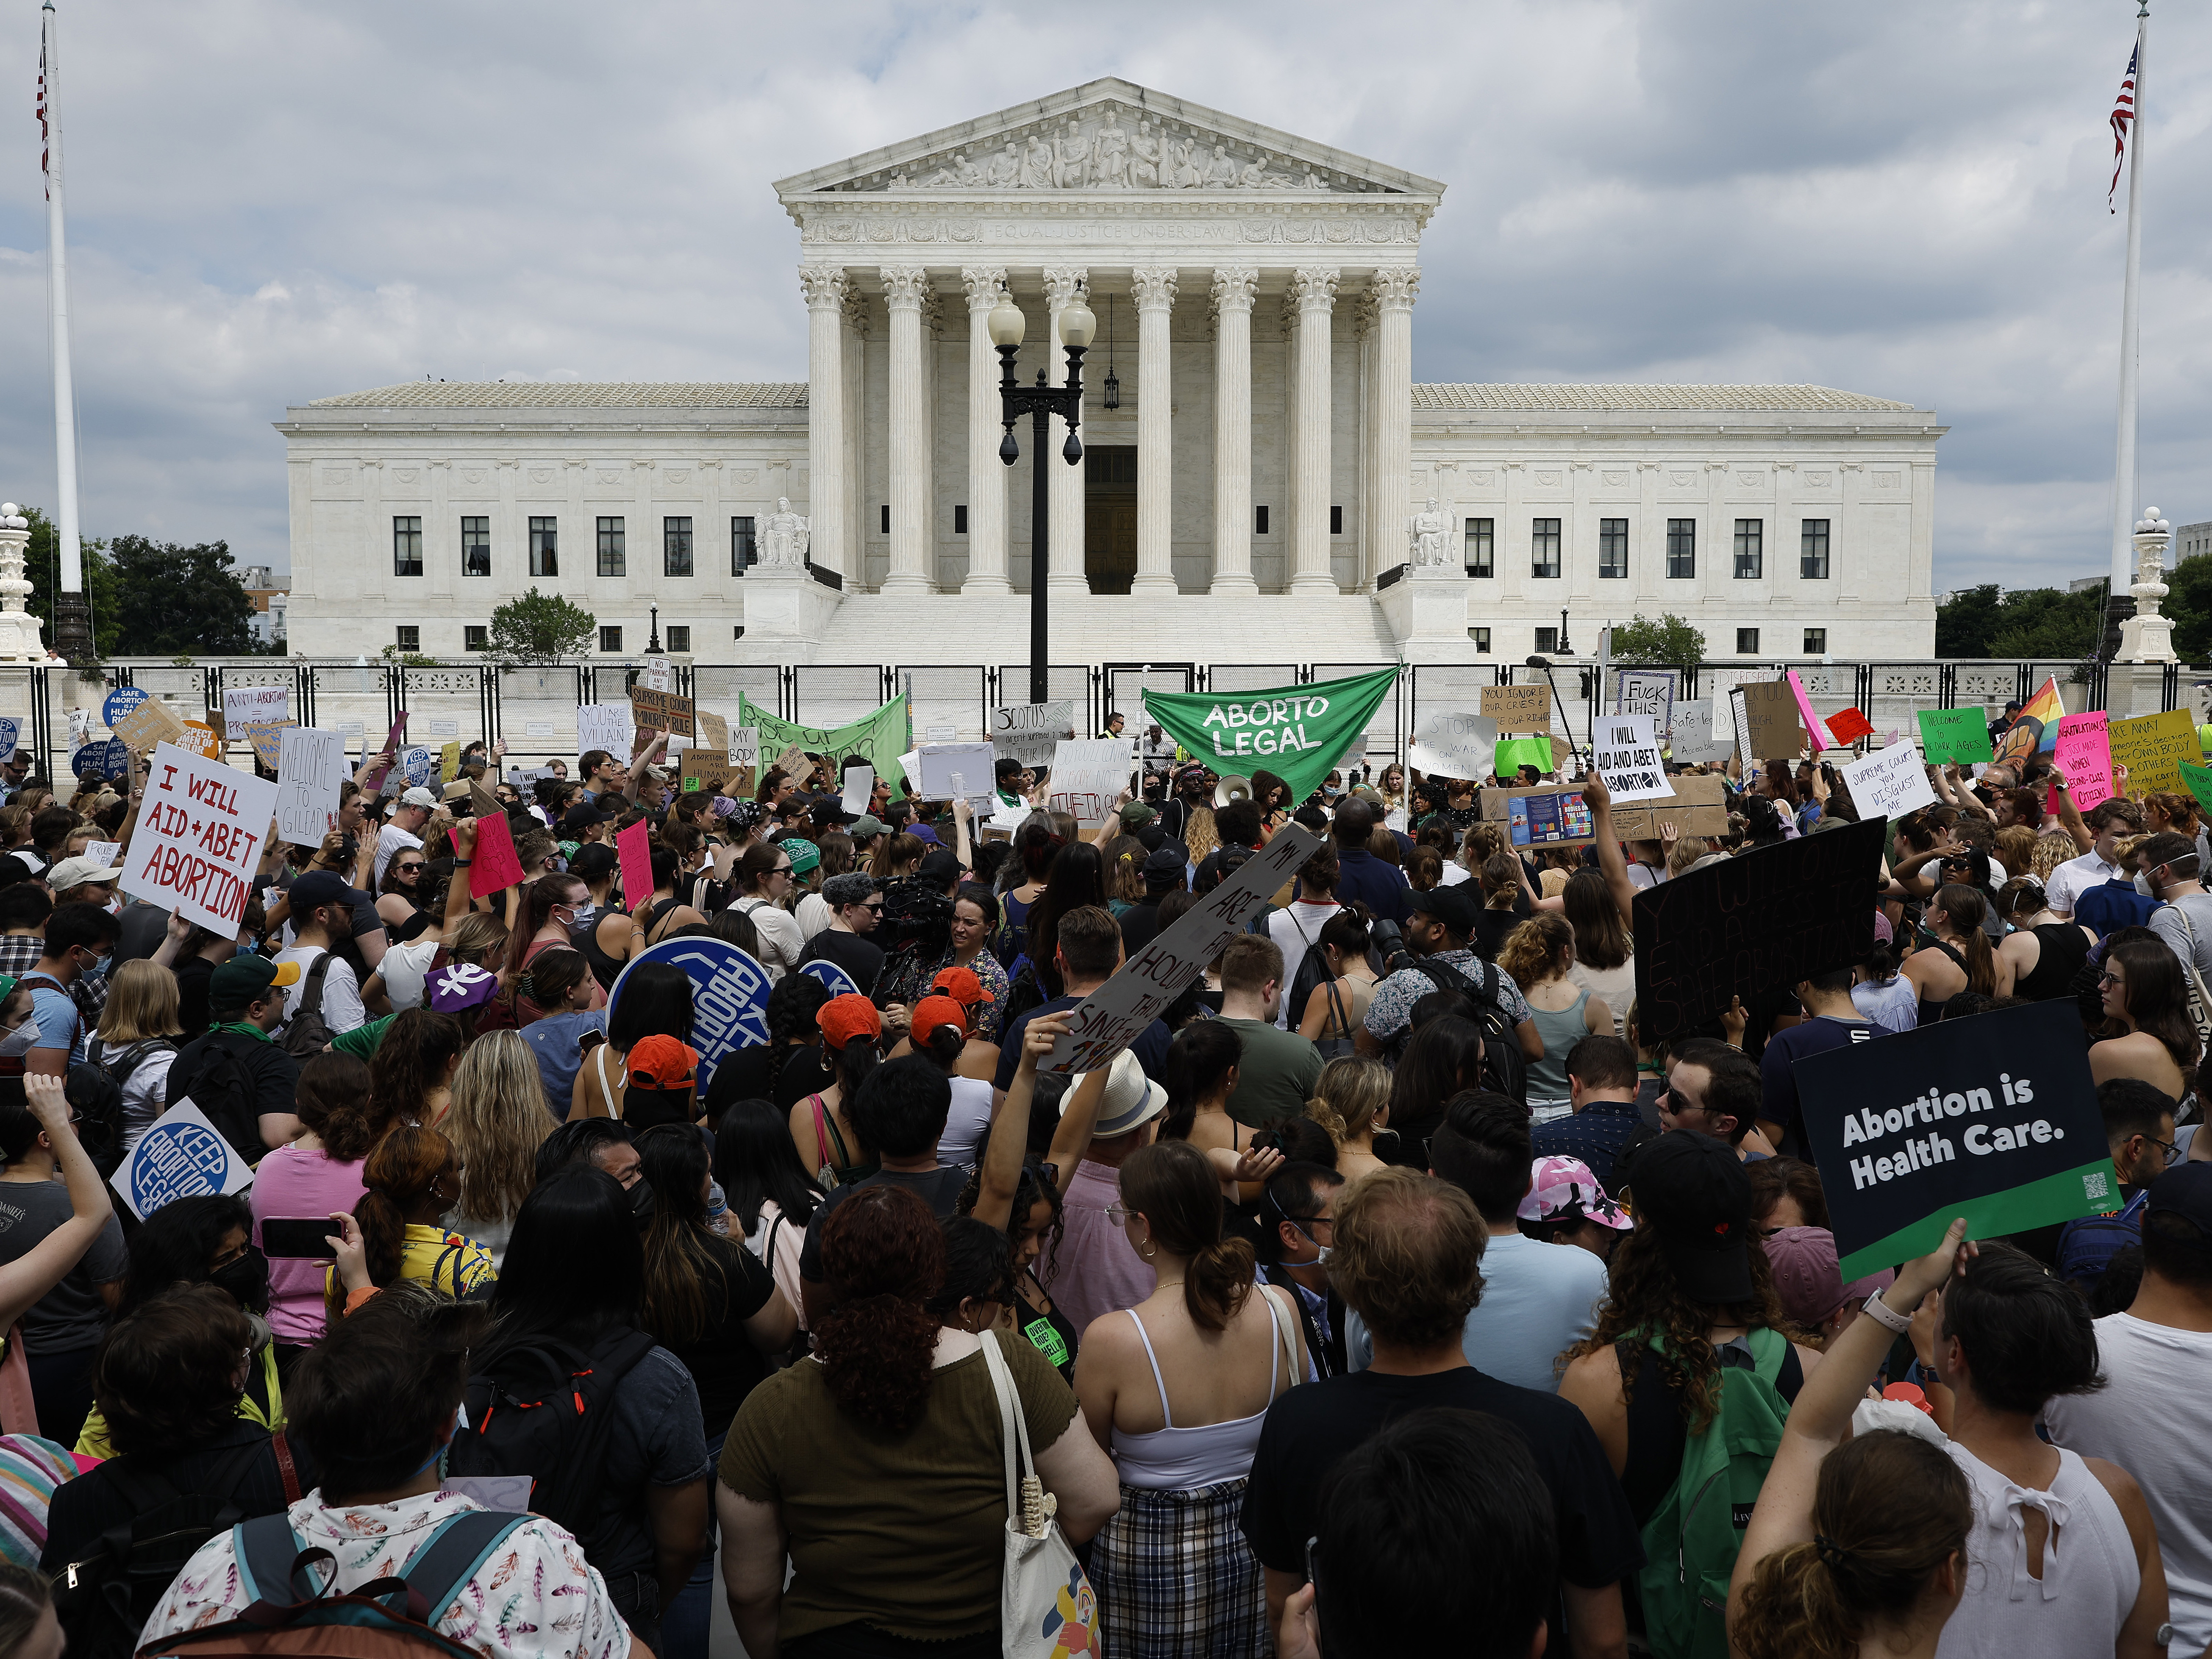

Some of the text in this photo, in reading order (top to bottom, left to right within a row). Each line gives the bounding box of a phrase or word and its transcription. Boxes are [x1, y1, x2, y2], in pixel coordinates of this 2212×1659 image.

[995, 225, 1227, 239] EQUAL JUSTICE UNDER LAW
[649, 668, 668, 678] PARKING
[655, 660, 663, 669] NO
[228, 689, 288, 707] ANTI-ABORTION
[633, 688, 691, 713] SUPREME COURT
[1484, 687, 1545, 699] YOU IGNORE
[1628, 681, 1666, 702] FUCK
[1762, 682, 1784, 701] YOU
[1202, 695, 1329, 729] ABORTO
[1485, 700, 1535, 712] OUR CRIES
[1624, 698, 1657, 715] THIS
[580, 706, 625, 726] YOU ARE
[607, 718, 624, 727] THE
[635, 709, 690, 734] MINORITY RULE
[997, 705, 1045, 730] SCOTUS
[1508, 715, 1526, 725] OUR
[1671, 711, 1695, 730] Safe
[1926, 713, 1964, 728] WELCOME
[1430, 715, 1474, 736] STOP
[1936, 729, 1944, 739] TO
[2131, 719, 2159, 735] AWAY
[202, 739, 214, 748] OF
[582, 728, 624, 744] VILLAIN
[733, 730, 749, 743] MY
[1006, 733, 1025, 744] aren't
[1028, 731, 1049, 741] supposed
[1212, 723, 1323, 757] LEGAL
[1555, 738, 1572, 750] CHOICE
[1612, 726, 1637, 745] I WILL
[1670, 732, 1686, 744] free
[2109, 732, 2190, 752] omeone's decision
[604, 745, 616, 753] OUR
[1058, 742, 1100, 766] SO YOU'LL
[1415, 739, 1477, 755] THE WAR
[1439, 750, 1452, 759] ON
[1496, 739, 1534, 753] BANS OFF
[1681, 739, 1716, 756] Accessible
[1924, 739, 1982, 752] THE DARK AGES
[2065, 739, 2099, 757] JUST MADE
[2111, 739, 2190, 762] their OWN BODY
[282, 735, 335, 791] WELCOME
[410, 750, 425, 763] KEEP
[729, 748, 756, 762] BODY
[1016, 748, 1038, 764] THEIR
[1503, 751, 1517, 762] OUR
[1598, 748, 1657, 771] AID AND ABET
[407, 759, 429, 775] ABORTION
[1853, 749, 1913, 786] SUPREME COURT
[2137, 757, 2174, 772] OTHERS
[410, 771, 427, 784] LEGAL
[693, 769, 729, 779] HUMAN
[1051, 768, 1121, 789] MY BODY NOT
[1604, 771, 1662, 793] ABORTION
[1879, 772, 1895, 786] YOU
[2156, 769, 2181, 781] carry
[159, 764, 239, 816] I WILL
[295, 786, 309, 807] TO
[1871, 774, 1916, 806] DISGUST
[2148, 781, 2171, 795] shoot
[1051, 792, 1107, 823] THEIR
[1887, 798, 1903, 814] ME
[145, 800, 258, 868] AID ABET
[479, 832, 508, 855] CHOICE
[1265, 839, 1301, 871] MY
[141, 843, 253, 924] ABORTION
[1638, 827, 1879, 942] YOU WILL ONLY
[1206, 885, 1262, 925] ARE
[1648, 877, 1867, 988] END ACCESS TO
[1653, 910, 1876, 1036] SAFE ABORTIONS
[1069, 1003, 1133, 1040] SINCE
[1843, 1072, 2034, 1149] Abortion is
[173, 1125, 225, 1175] KEEP
[1848, 1119, 2065, 1191] Health Care.
[1034, 1331, 1050, 1347] ROE?
[1314, 1326, 1325, 1347] NEWS
[1041, 1341, 1060, 1358] HELL
